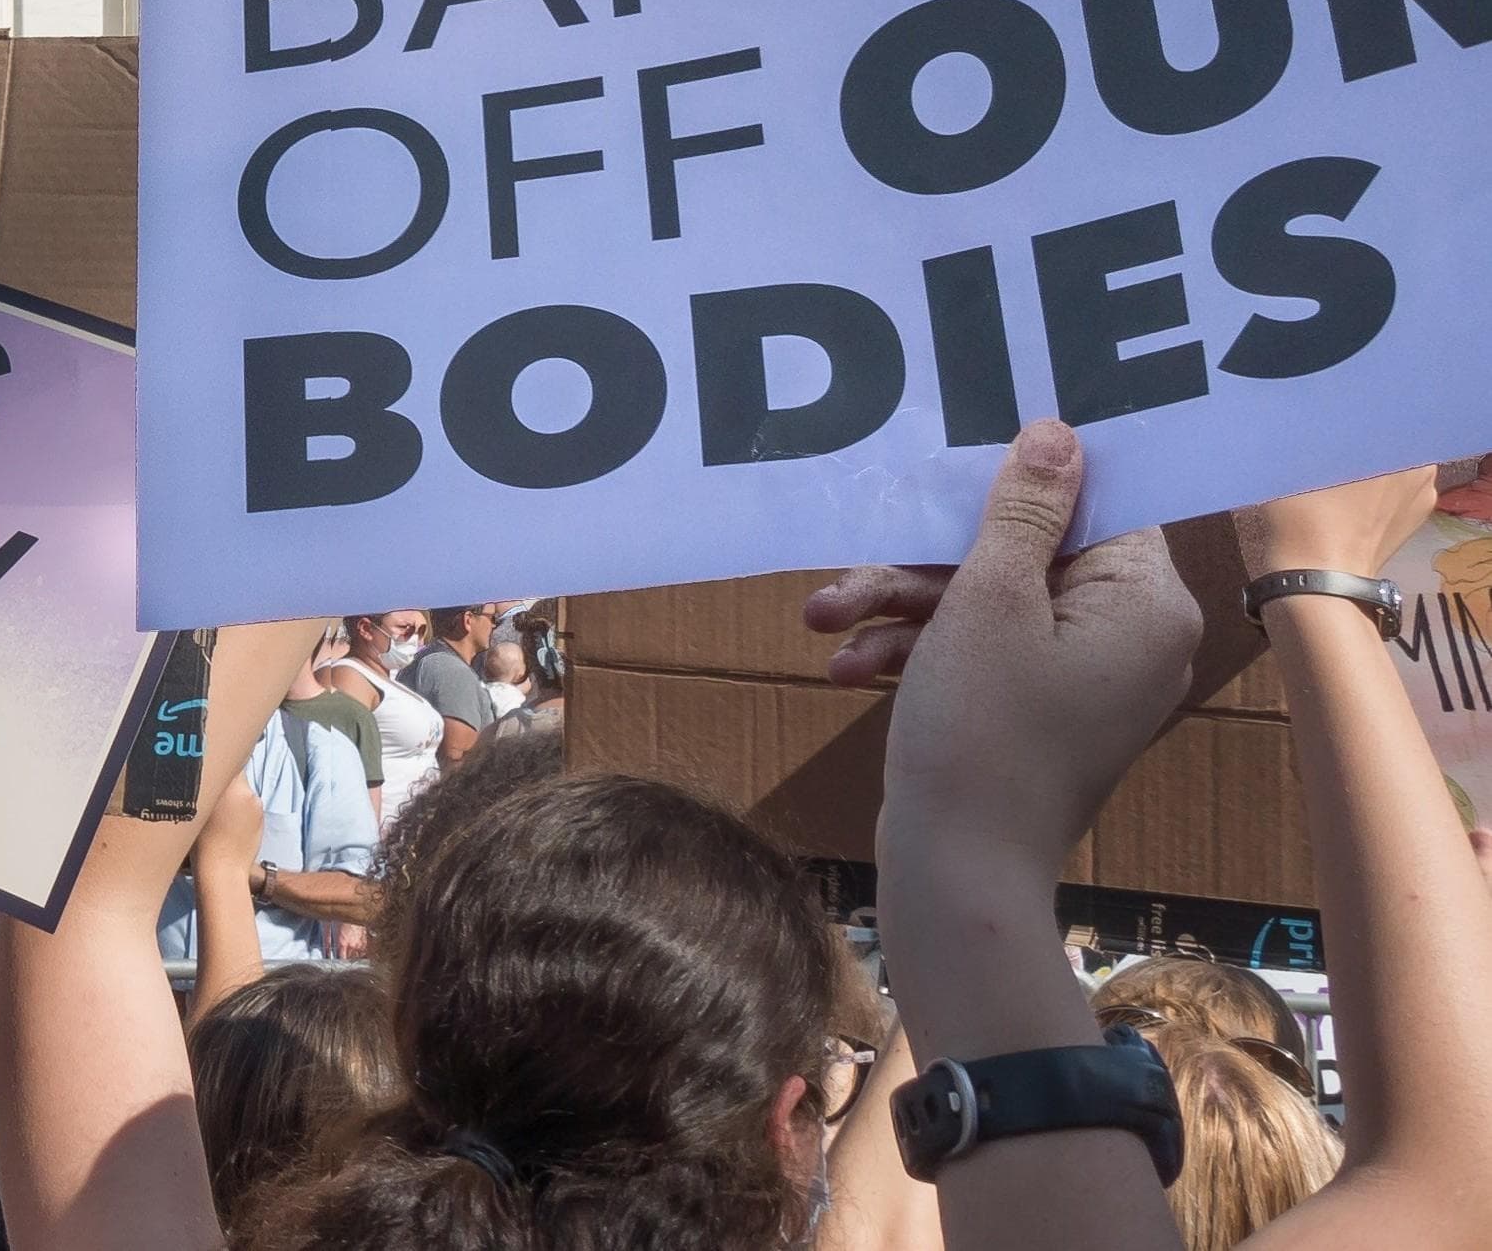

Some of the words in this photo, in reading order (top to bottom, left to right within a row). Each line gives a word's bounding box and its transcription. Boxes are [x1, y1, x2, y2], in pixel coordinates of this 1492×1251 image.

[237, 46, 766, 281] OFF
[242, 155, 1398, 514] BODIES
[156, 799, 184, 809] shows
[1151, 902, 1165, 934] free
